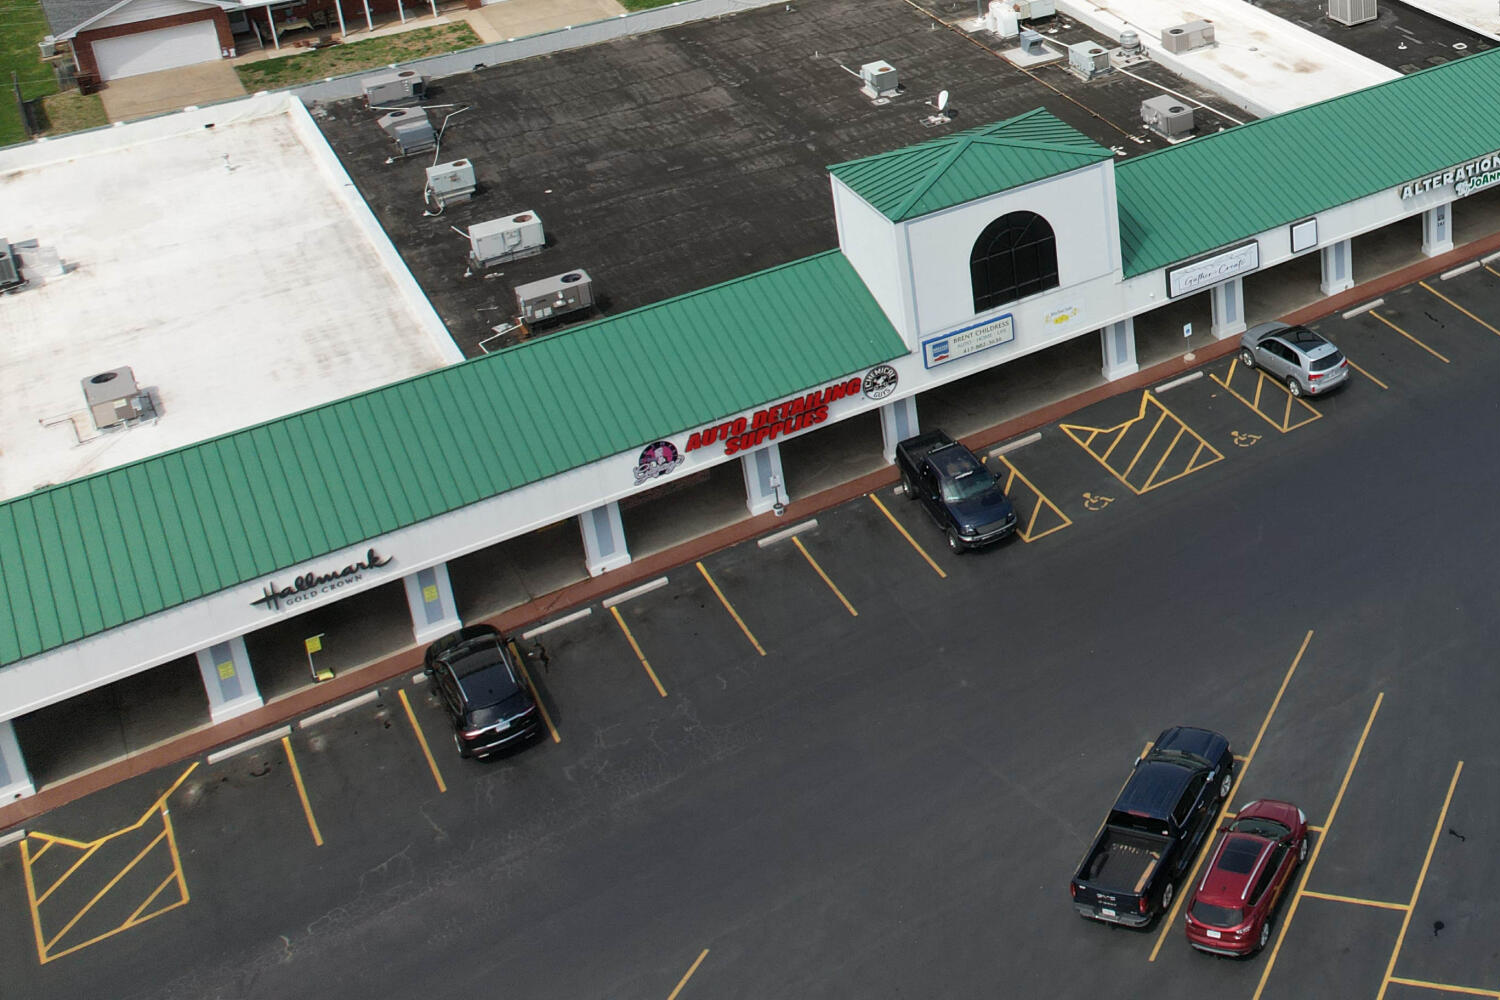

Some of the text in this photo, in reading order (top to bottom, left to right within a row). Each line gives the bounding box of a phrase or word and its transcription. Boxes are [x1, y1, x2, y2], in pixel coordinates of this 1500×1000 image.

[953, 320, 1010, 344] BRENT CHILDRESS
[864, 366, 897, 389] CHEMICAL
[873, 388, 890, 398] GUYS
[685, 417, 747, 453] AUTO
[751, 377, 862, 429] DETAILING
[725, 406, 829, 456] SUPPLIES
[250, 548, 394, 611] Hallmark
[286, 574, 363, 606] GOLD CROWN
